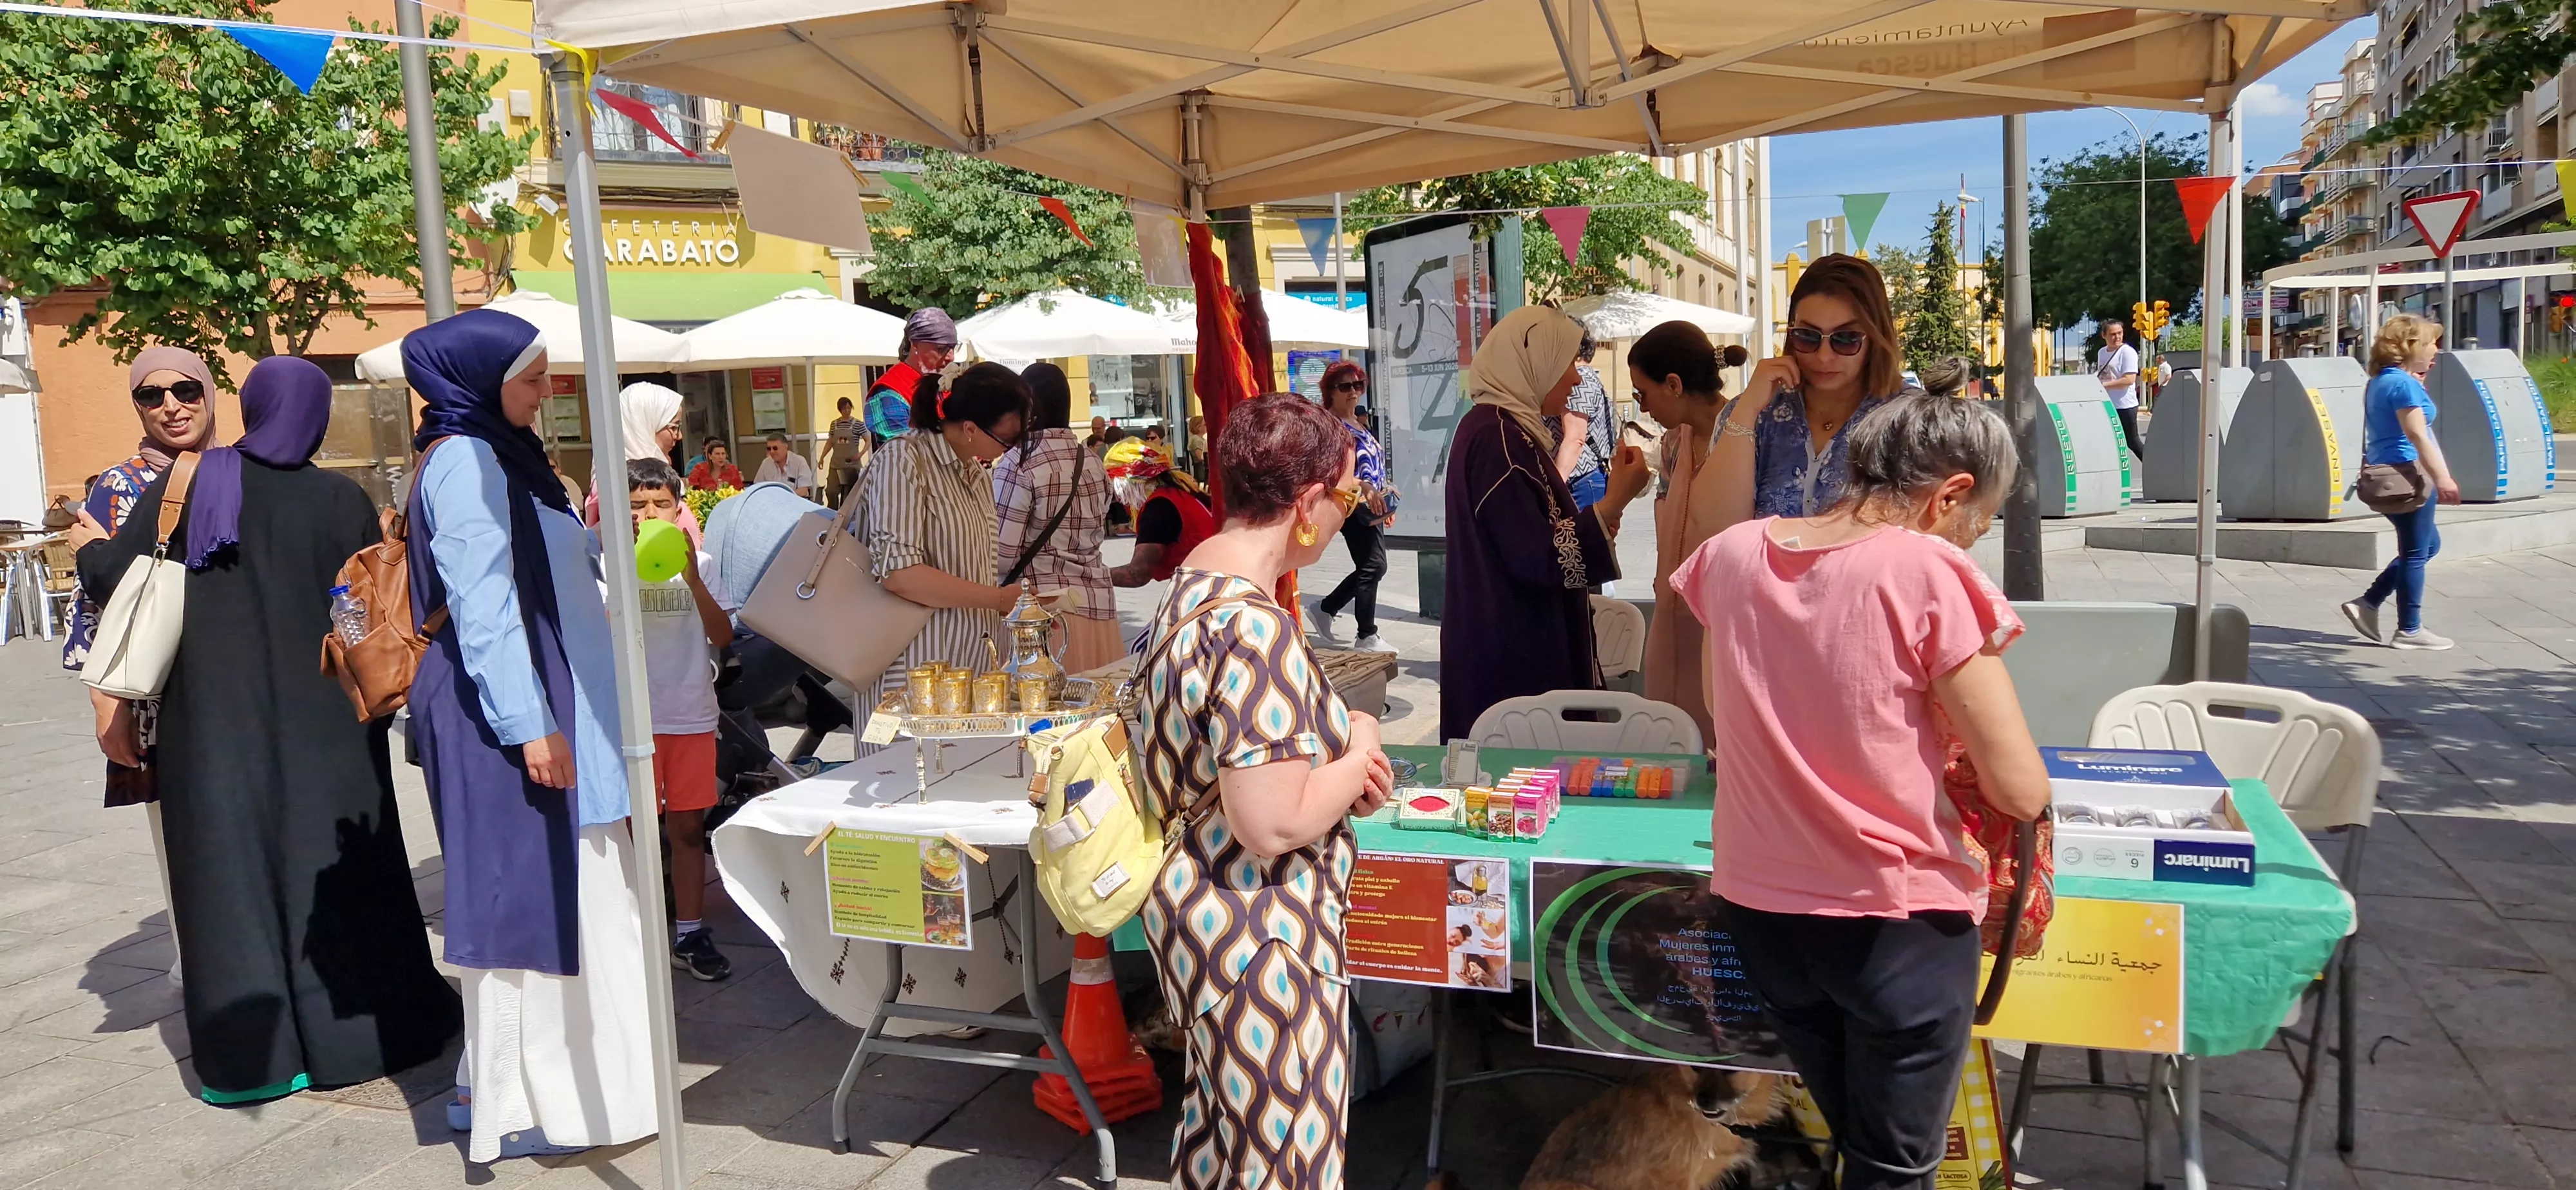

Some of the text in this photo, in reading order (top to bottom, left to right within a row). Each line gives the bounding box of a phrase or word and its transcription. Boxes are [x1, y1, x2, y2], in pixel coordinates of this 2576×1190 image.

[562, 219, 737, 237] CFETERIA
[1170, 337, 1197, 346] Maho
[1392, 365, 1414, 375] HUESCA
[1421, 364, 1434, 373] 5-13
[2111, 416, 2128, 471] RESTO
[2313, 395, 2340, 482] ENVASES
[2056, 420, 2074, 475] RESTO
[639, 588, 695, 612] UMA
[2130, 859, 2139, 868] 6
[2163, 853, 2250, 873] Luminarc
[1659, 940, 1709, 951] Mujeres
[1665, 953, 1709, 963] árabes
[2058, 950, 2104, 966] النساء
[2111, 952, 2162, 974] جمعية
[1692, 967, 1747, 979] HUESC
[2047, 970, 2072, 979] árabes
[2078, 972, 2113, 982] africanas
